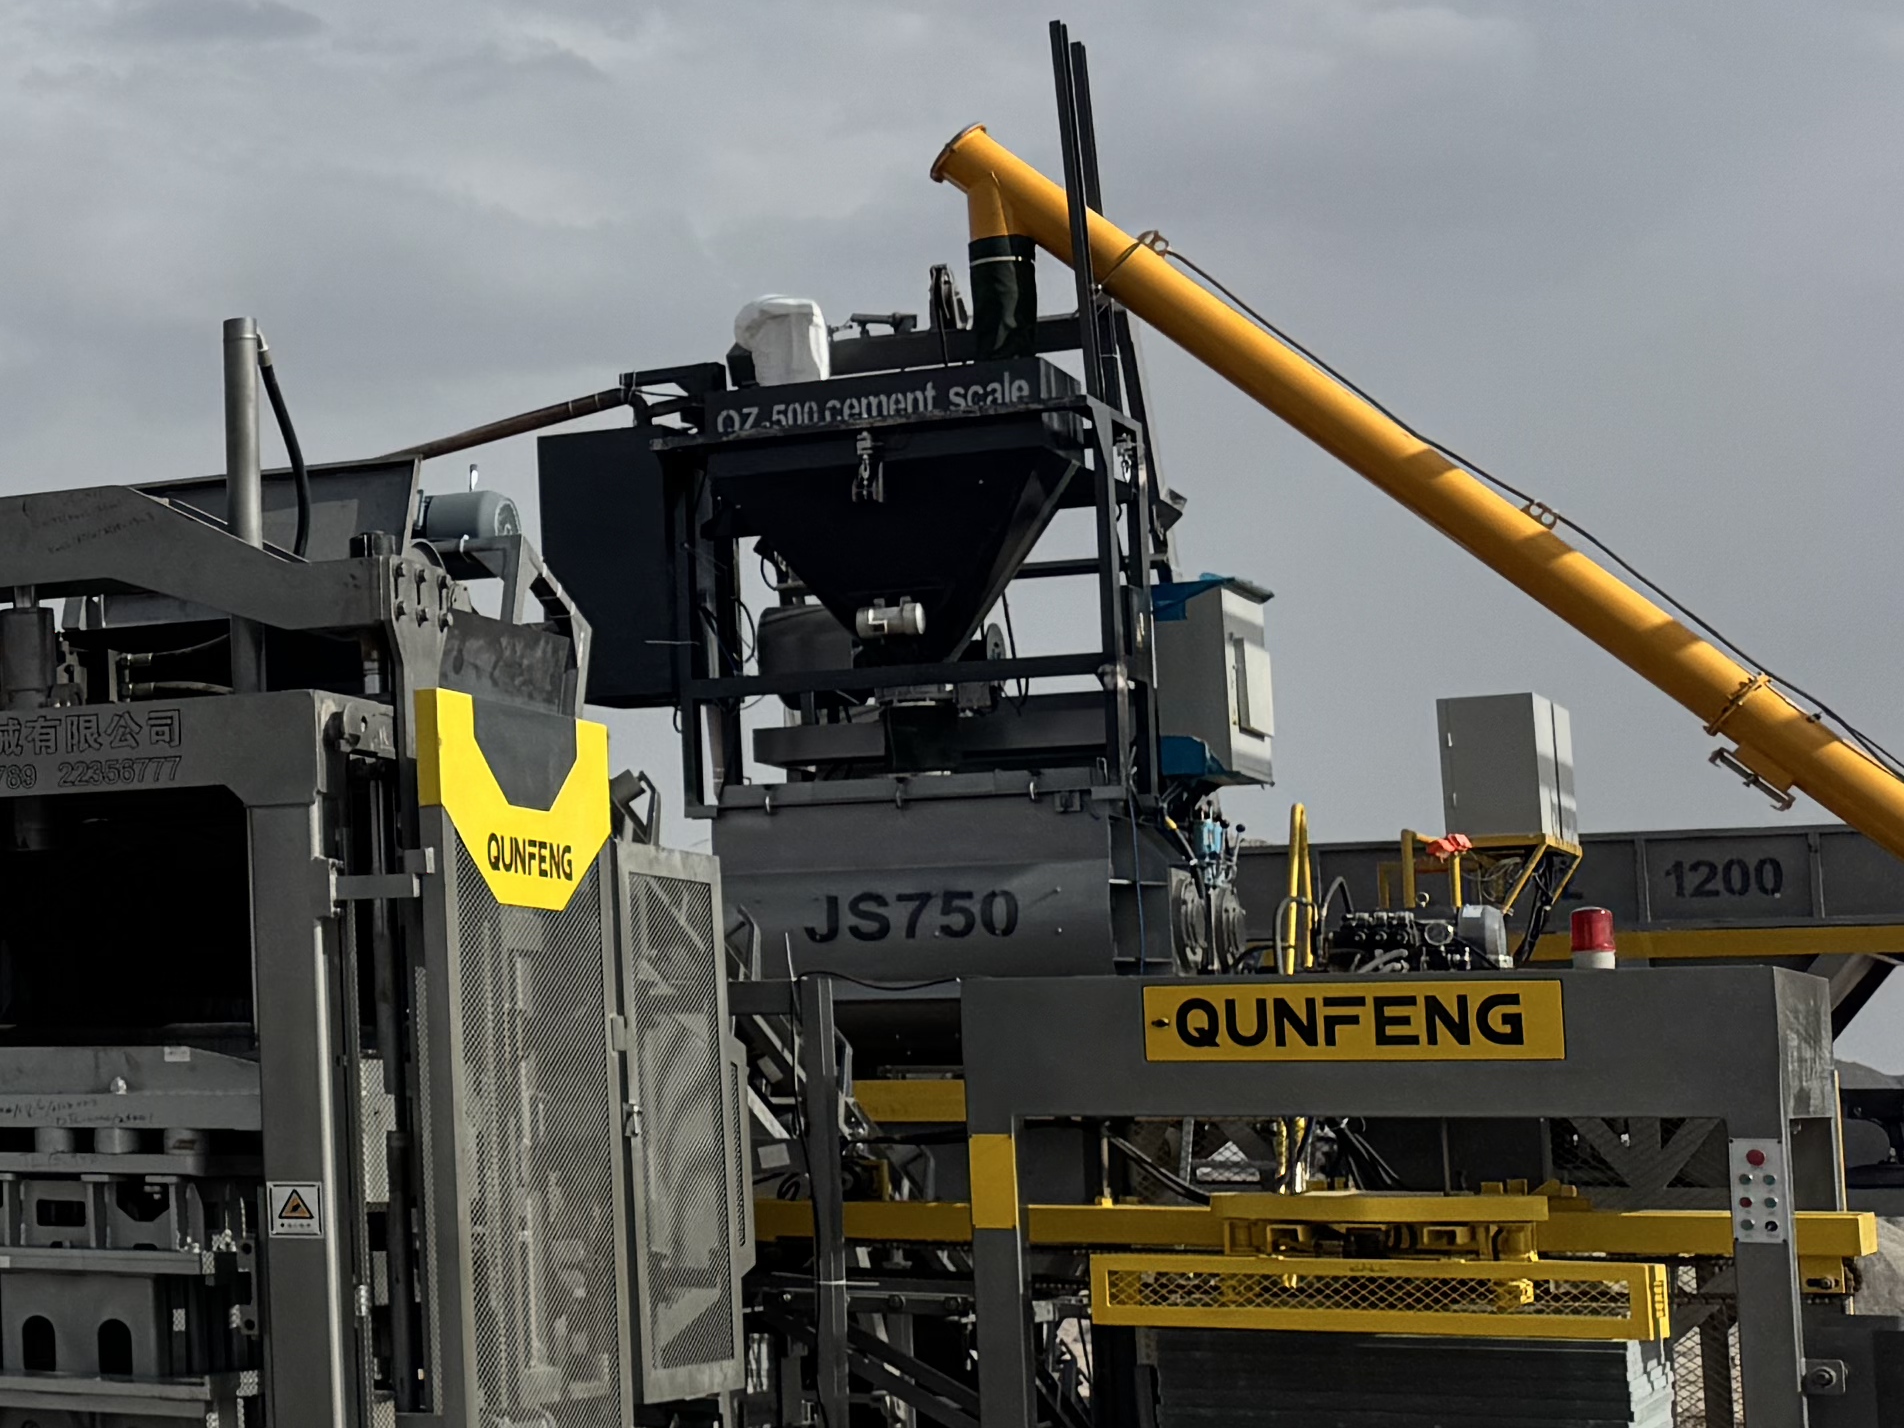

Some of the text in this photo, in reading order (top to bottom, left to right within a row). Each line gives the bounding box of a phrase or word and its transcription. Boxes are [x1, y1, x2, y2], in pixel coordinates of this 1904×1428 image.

[825, 381, 936, 422] cement
[948, 371, 1030, 409] scale
[58, 755, 182, 789] 22356777
[487, 833, 573, 883] QUNFENG
[1665, 857, 1784, 898] 1200
[804, 889, 1019, 943] JS750
[1176, 993, 1526, 1049] QUNFENG
